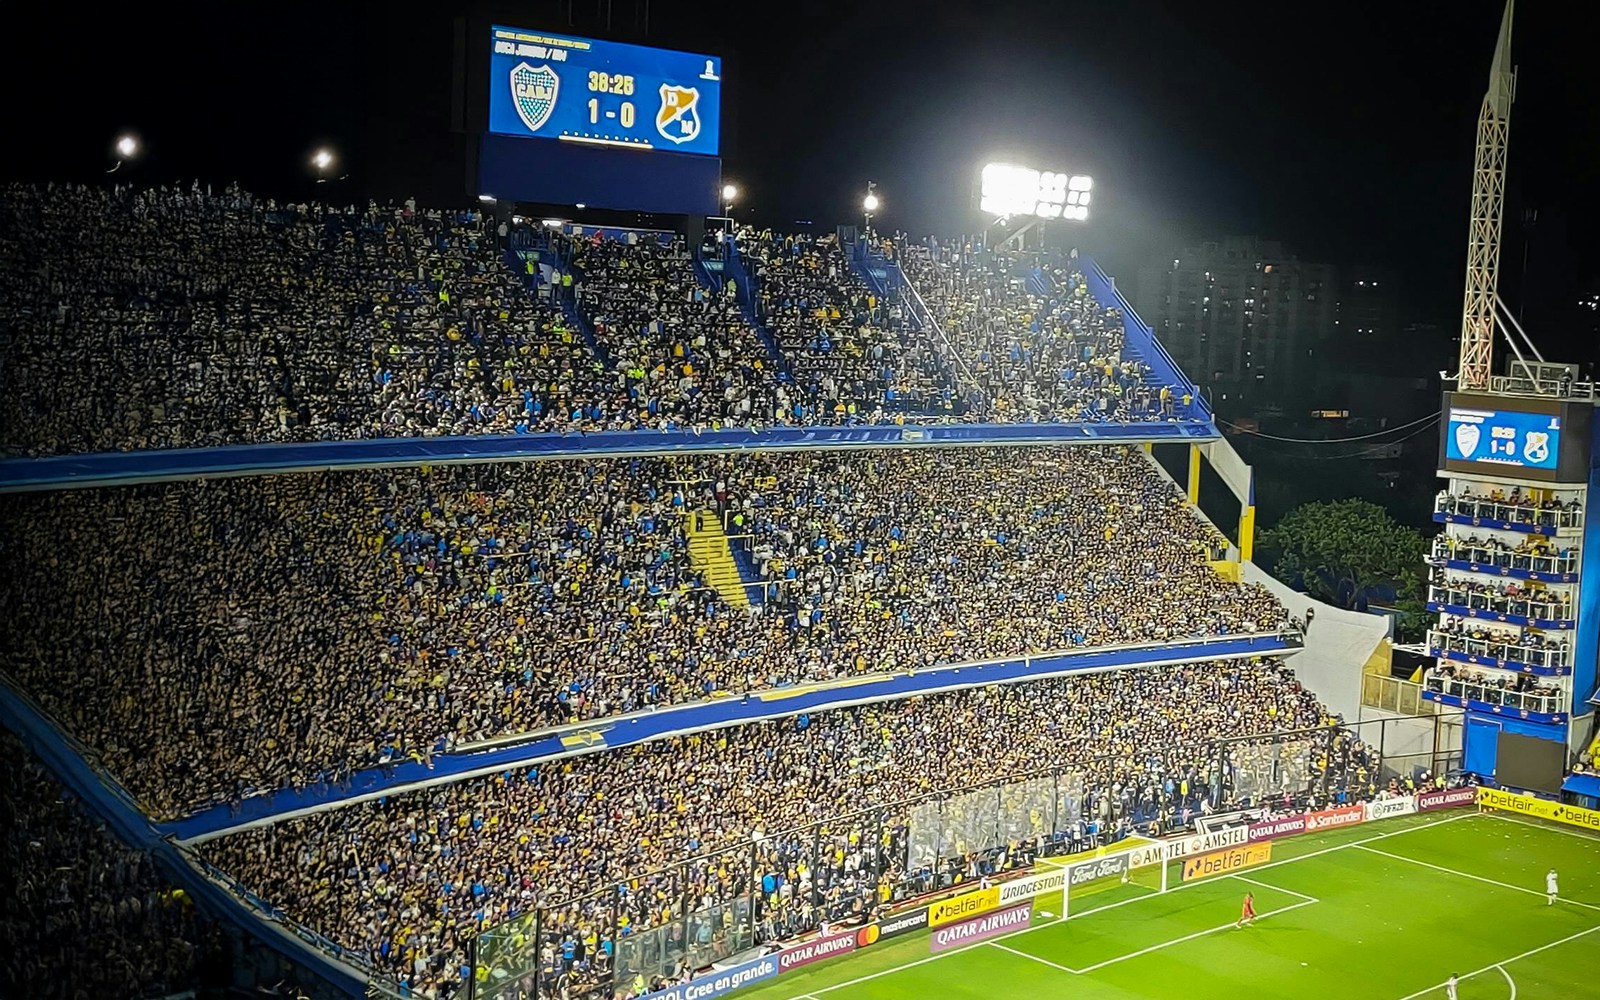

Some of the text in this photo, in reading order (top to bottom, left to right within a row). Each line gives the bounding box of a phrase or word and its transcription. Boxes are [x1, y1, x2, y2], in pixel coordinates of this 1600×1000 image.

[588, 98, 598, 124] 1
[620, 102, 634, 128] 0
[1420, 796, 1445, 808] QATAR
[1249, 819, 1304, 839] QATAR AIRWAYS
[1316, 810, 1362, 828] Santander
[1203, 828, 1246, 850] AMSTEL
[1071, 857, 1122, 884] Ford Ford
[880, 911, 927, 935] mastercard
[937, 907, 1030, 945] QATAR AIRWAYS
[780, 934, 854, 967] QATAR AIRWAYS
[685, 982, 714, 1000] Cree
[714, 976, 732, 990] en
